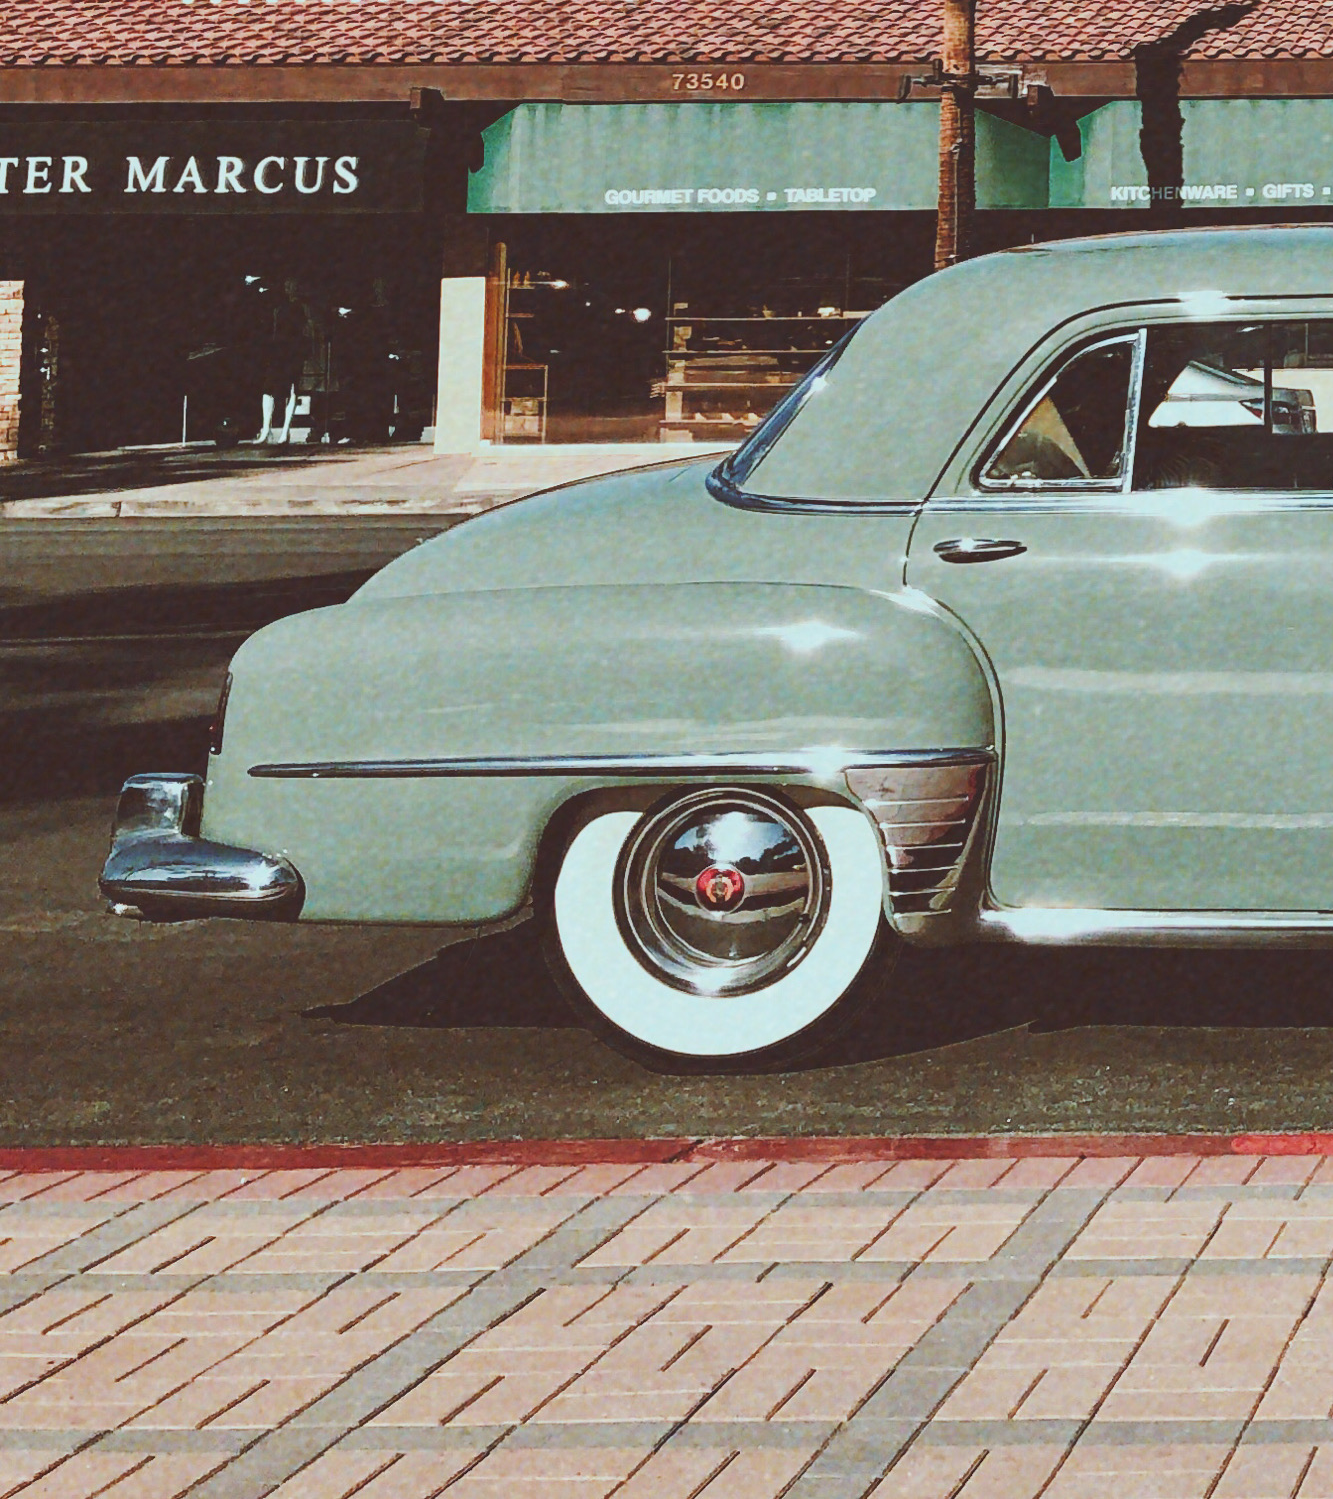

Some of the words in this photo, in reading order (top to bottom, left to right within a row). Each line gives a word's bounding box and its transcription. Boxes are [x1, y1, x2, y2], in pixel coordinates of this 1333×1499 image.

[671, 73, 746, 91] 73540
[123, 155, 360, 195] MARCUS
[604, 189, 693, 205] GOURMET
[697, 188, 760, 204] FOODS
[784, 187, 877, 203] TABLETOP
[1110, 184, 1238, 201] KITCHENWARE
[1262, 183, 1315, 199] GIFTS
